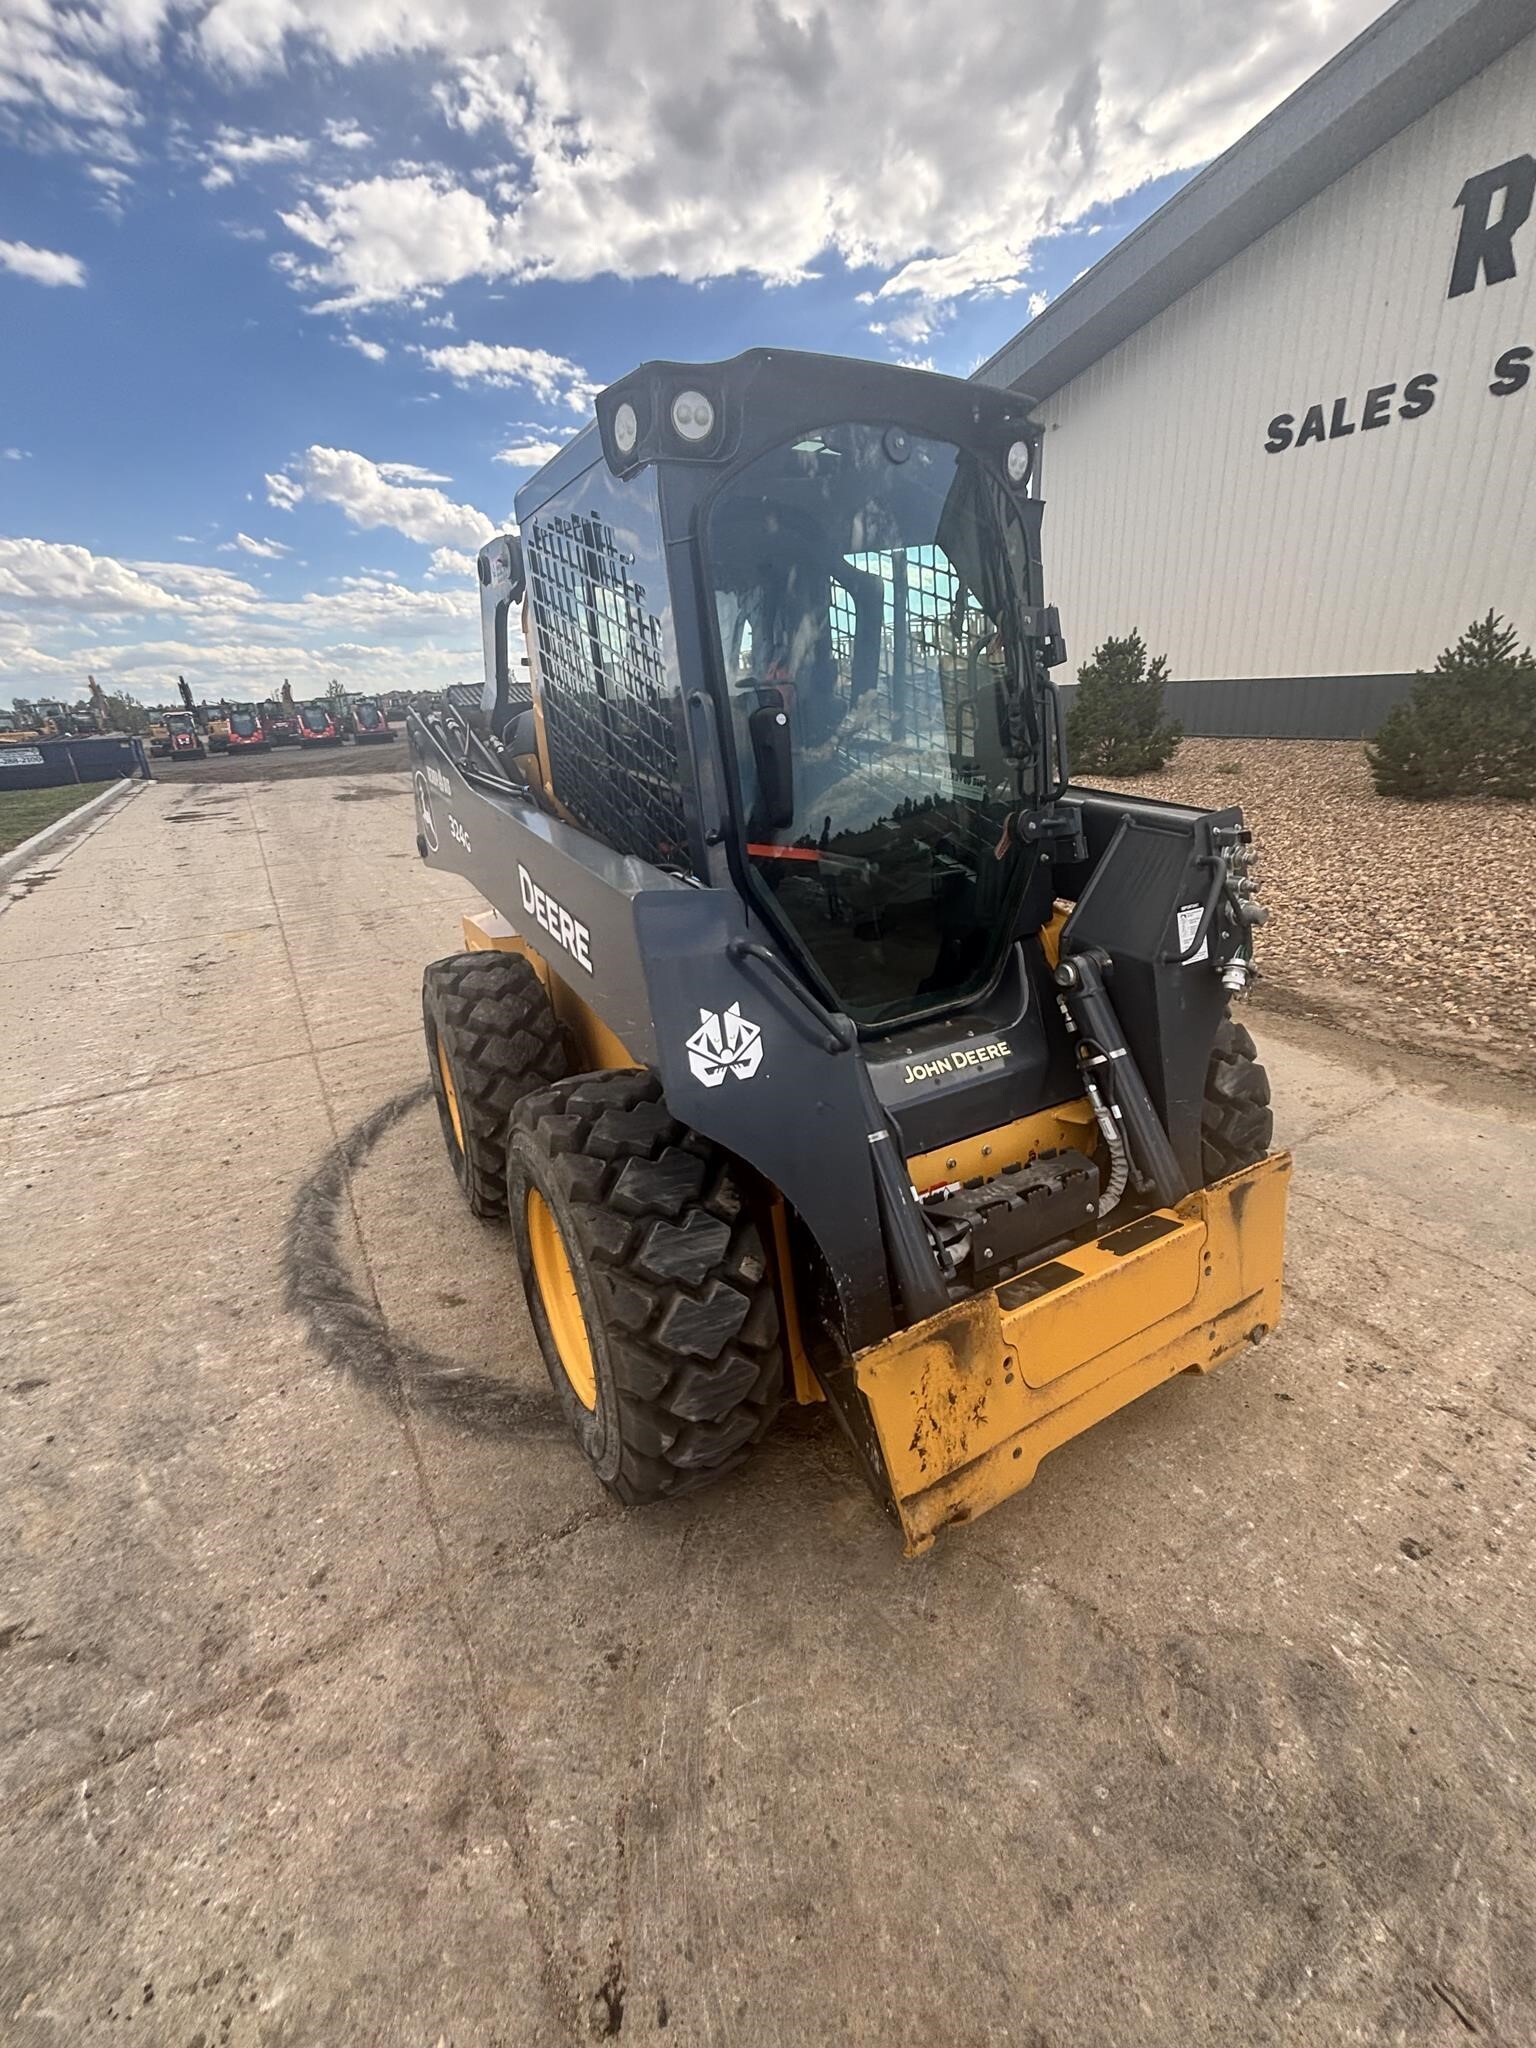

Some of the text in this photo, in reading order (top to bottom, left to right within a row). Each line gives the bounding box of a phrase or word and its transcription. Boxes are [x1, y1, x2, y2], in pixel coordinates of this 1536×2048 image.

[1447, 153, 1536, 299] R
[1264, 346, 1534, 454] SALES S
[518, 863, 593, 974] DEERE
[904, 1041, 1011, 1084] JOHN DEERE
